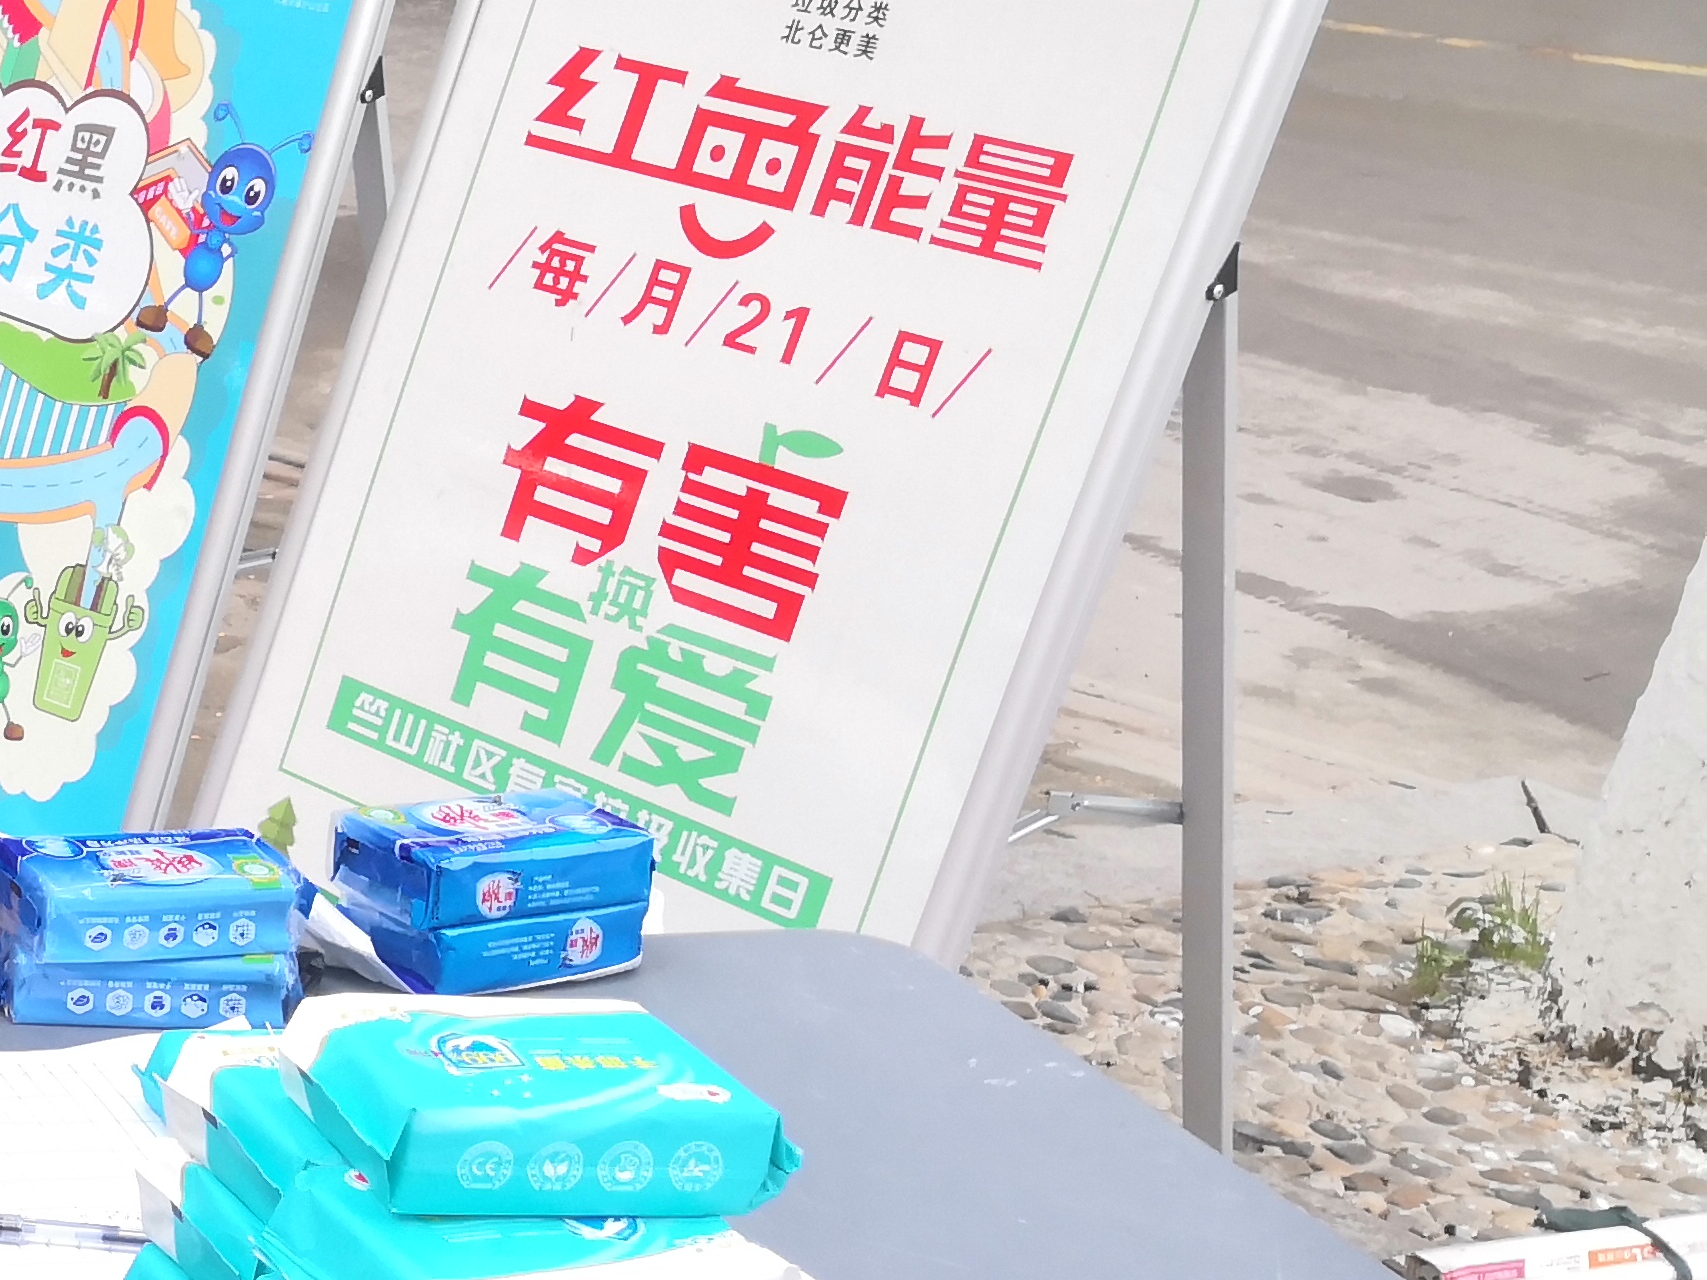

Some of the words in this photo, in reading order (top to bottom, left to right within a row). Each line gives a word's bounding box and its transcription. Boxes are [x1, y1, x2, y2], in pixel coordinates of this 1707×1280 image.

[780, 19, 880, 62] 北仑更美
[523, 44, 1076, 274] 红色能量
[500, 395, 850, 643] 有害
[587, 560, 657, 634] 换
[451, 560, 775, 818] 有爱
